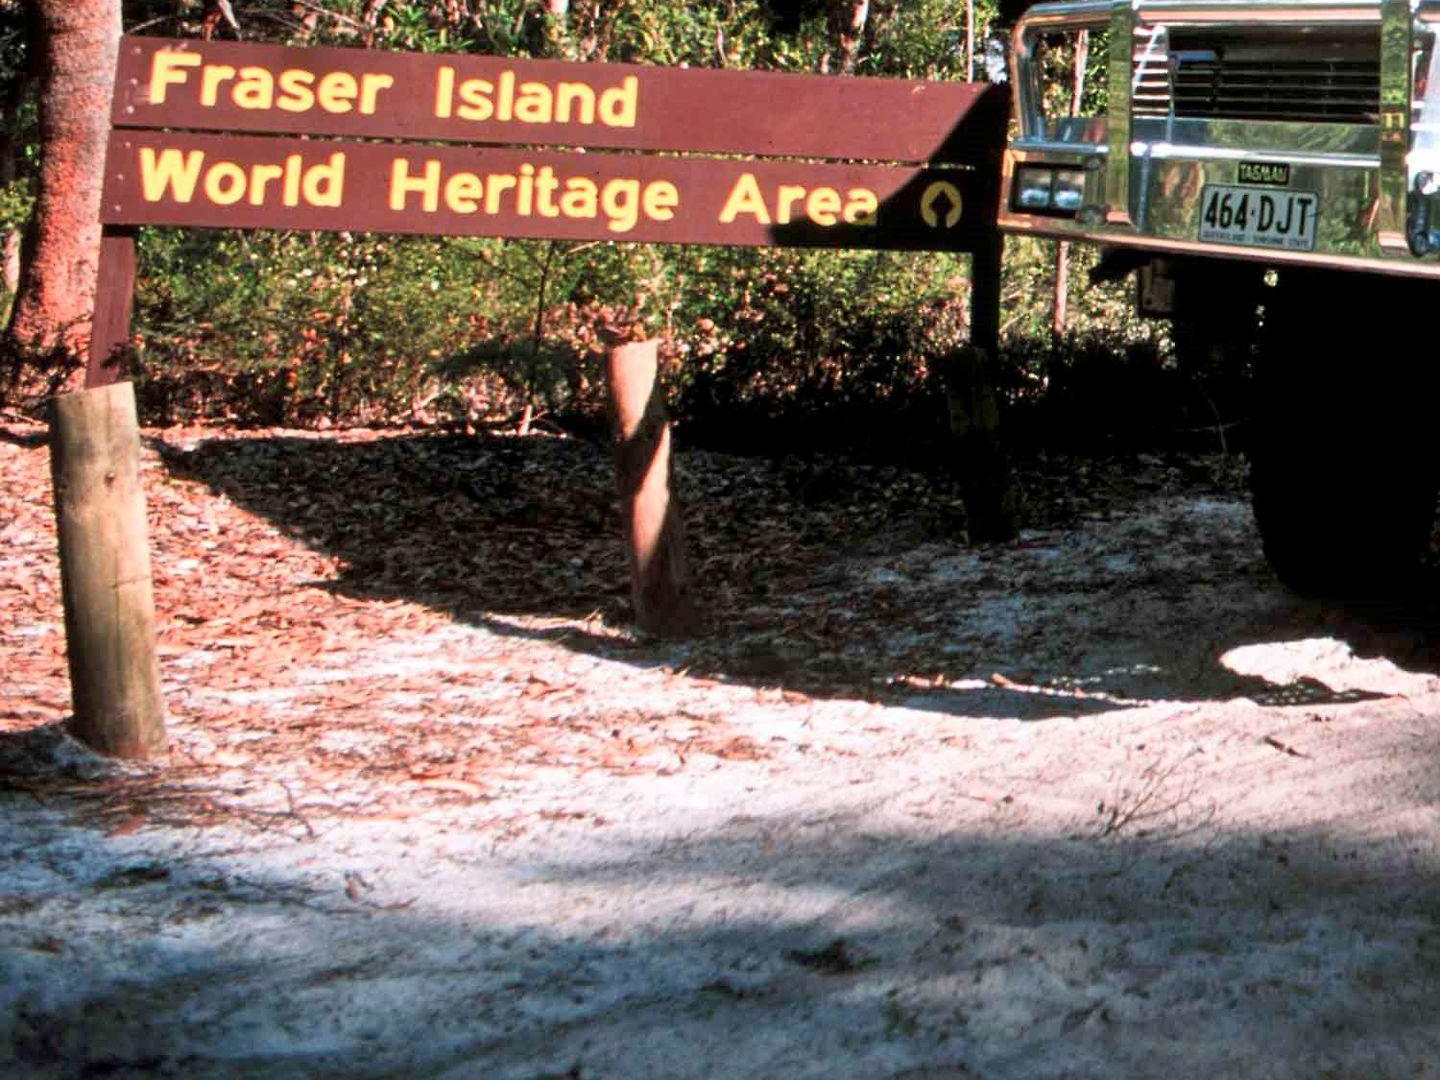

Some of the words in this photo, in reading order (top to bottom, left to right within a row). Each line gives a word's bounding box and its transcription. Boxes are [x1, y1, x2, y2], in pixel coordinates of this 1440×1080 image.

[148, 51, 393, 116] Fraser
[435, 67, 640, 128] Island
[139, 148, 346, 208] World
[389, 158, 680, 232] Heritage
[720, 173, 880, 226] Area
